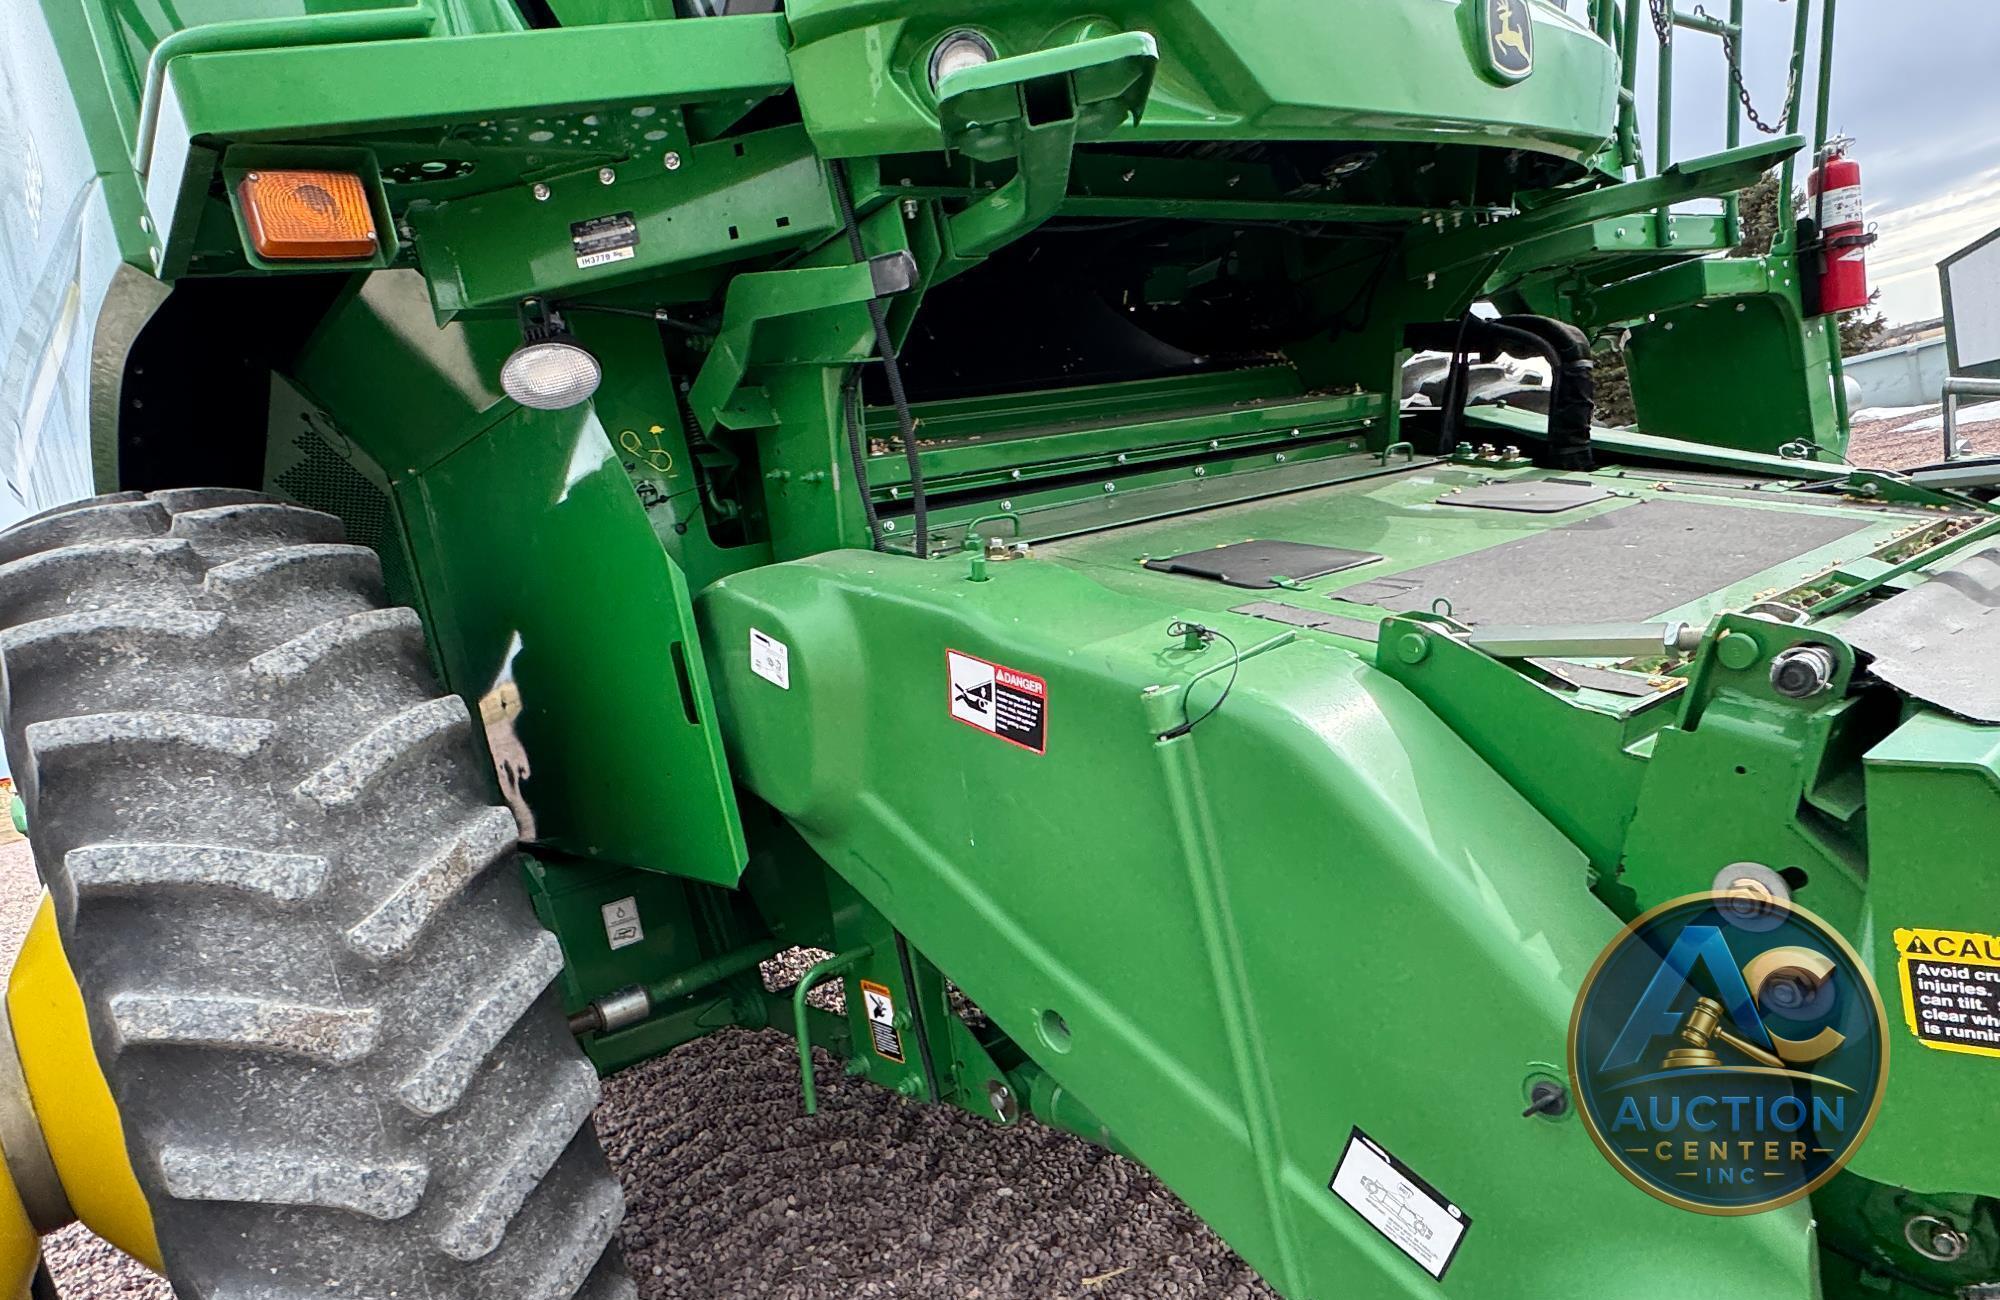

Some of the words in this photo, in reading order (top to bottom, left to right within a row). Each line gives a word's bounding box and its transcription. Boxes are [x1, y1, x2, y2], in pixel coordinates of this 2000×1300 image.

[1003, 671, 1043, 694] DANGER
[1916, 963, 1970, 980] Avoid
[1918, 978, 1992, 997] injuries.
[1920, 994, 1953, 1007] can
[1957, 996, 1988, 1011] tilt.
[1921, 1008, 1968, 1023] clear
[1924, 1021, 1941, 1035] is
